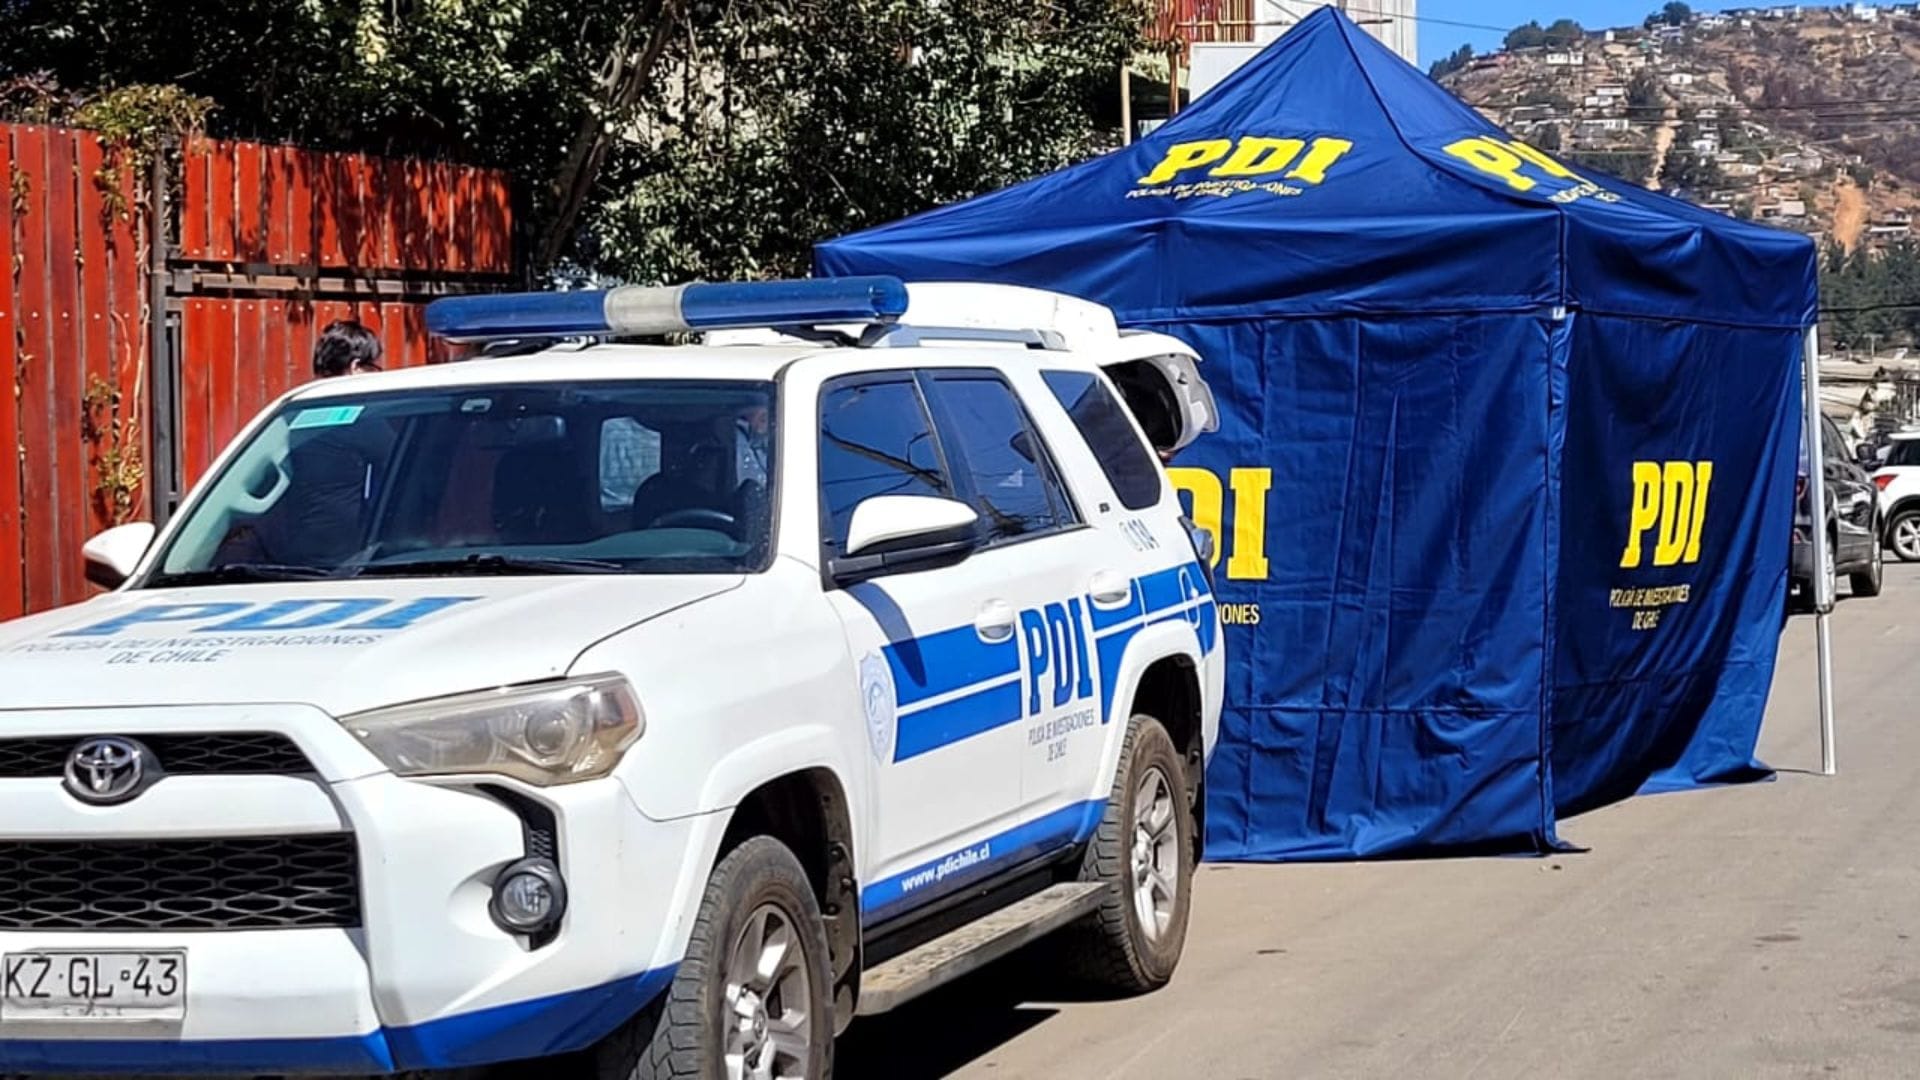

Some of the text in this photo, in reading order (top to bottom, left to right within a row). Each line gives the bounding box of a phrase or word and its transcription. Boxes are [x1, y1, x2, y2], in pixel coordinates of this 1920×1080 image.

[1137, 136, 1353, 184] PDI
[1166, 467, 1272, 579] DI
[1619, 461, 1713, 568] PDI
[48, 596, 485, 638] PDI
[107, 649, 230, 664] DE CHILE
[1019, 597, 1093, 716] PDI
[901, 842, 990, 892] www.pdichile.cl
